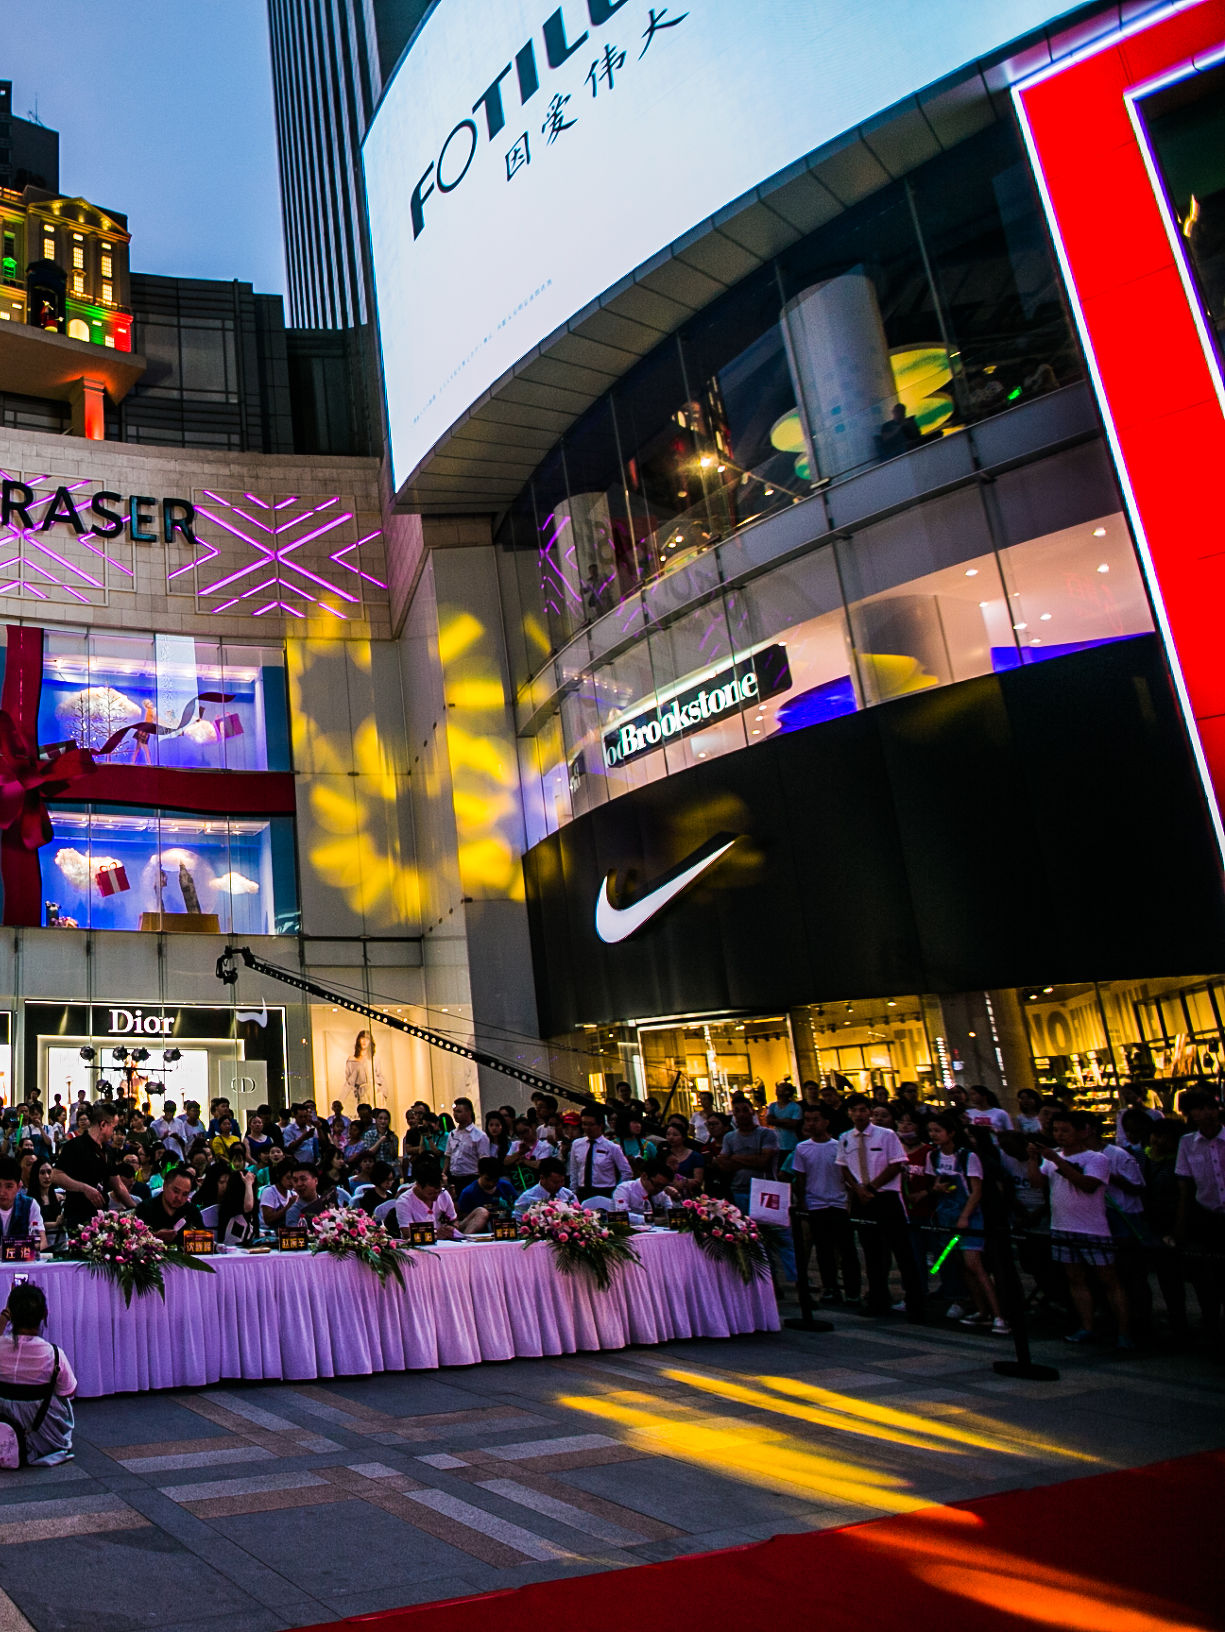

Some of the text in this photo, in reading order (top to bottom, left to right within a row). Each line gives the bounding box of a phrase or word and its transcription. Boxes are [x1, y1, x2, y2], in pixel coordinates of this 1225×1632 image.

[504, 8, 690, 182] 因爱伟大
[620, 671, 760, 757] Brookstone
[108, 1009, 175, 1034] Dior
